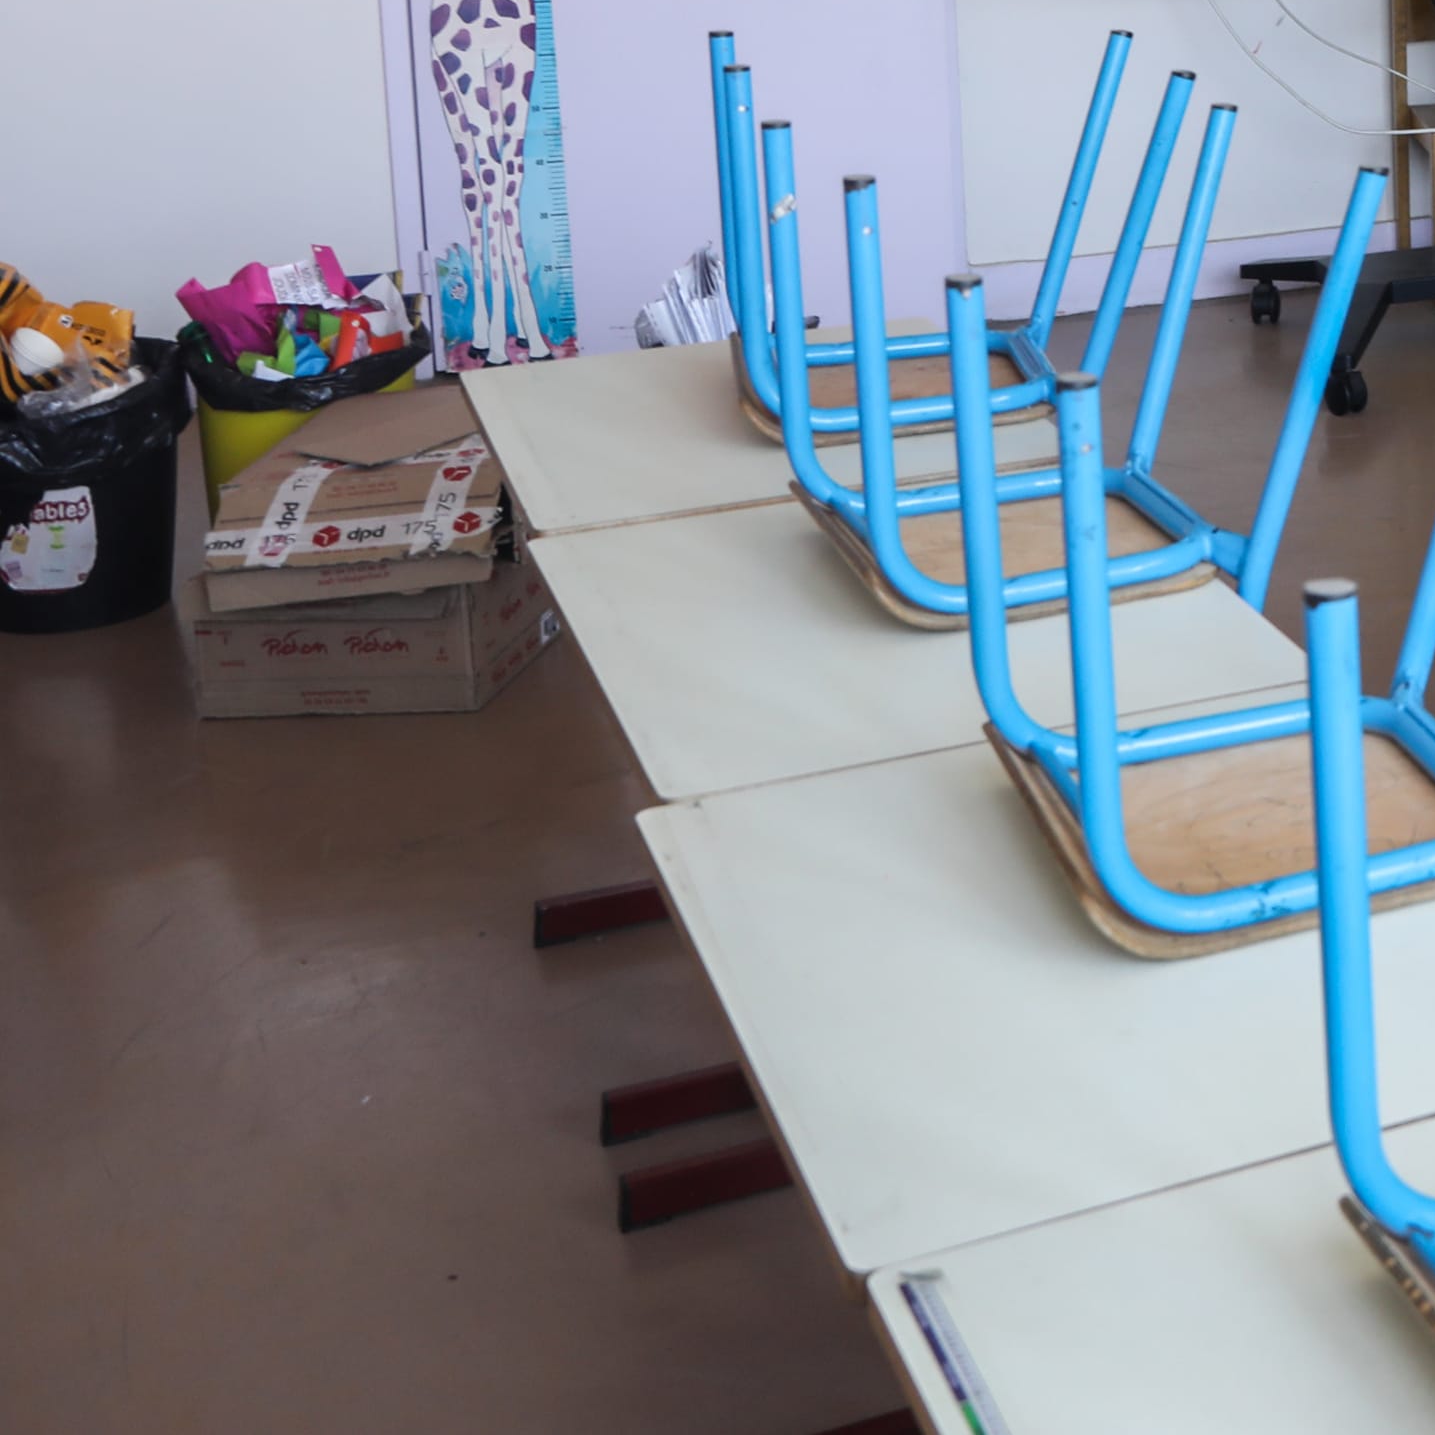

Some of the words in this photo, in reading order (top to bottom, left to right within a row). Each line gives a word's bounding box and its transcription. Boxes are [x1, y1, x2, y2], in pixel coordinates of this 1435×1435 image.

[277, 501, 300, 531] dpd
[347, 524, 386, 543] dpd
[402, 521, 436, 537] 175
[344, 626, 409, 653] Pichon
